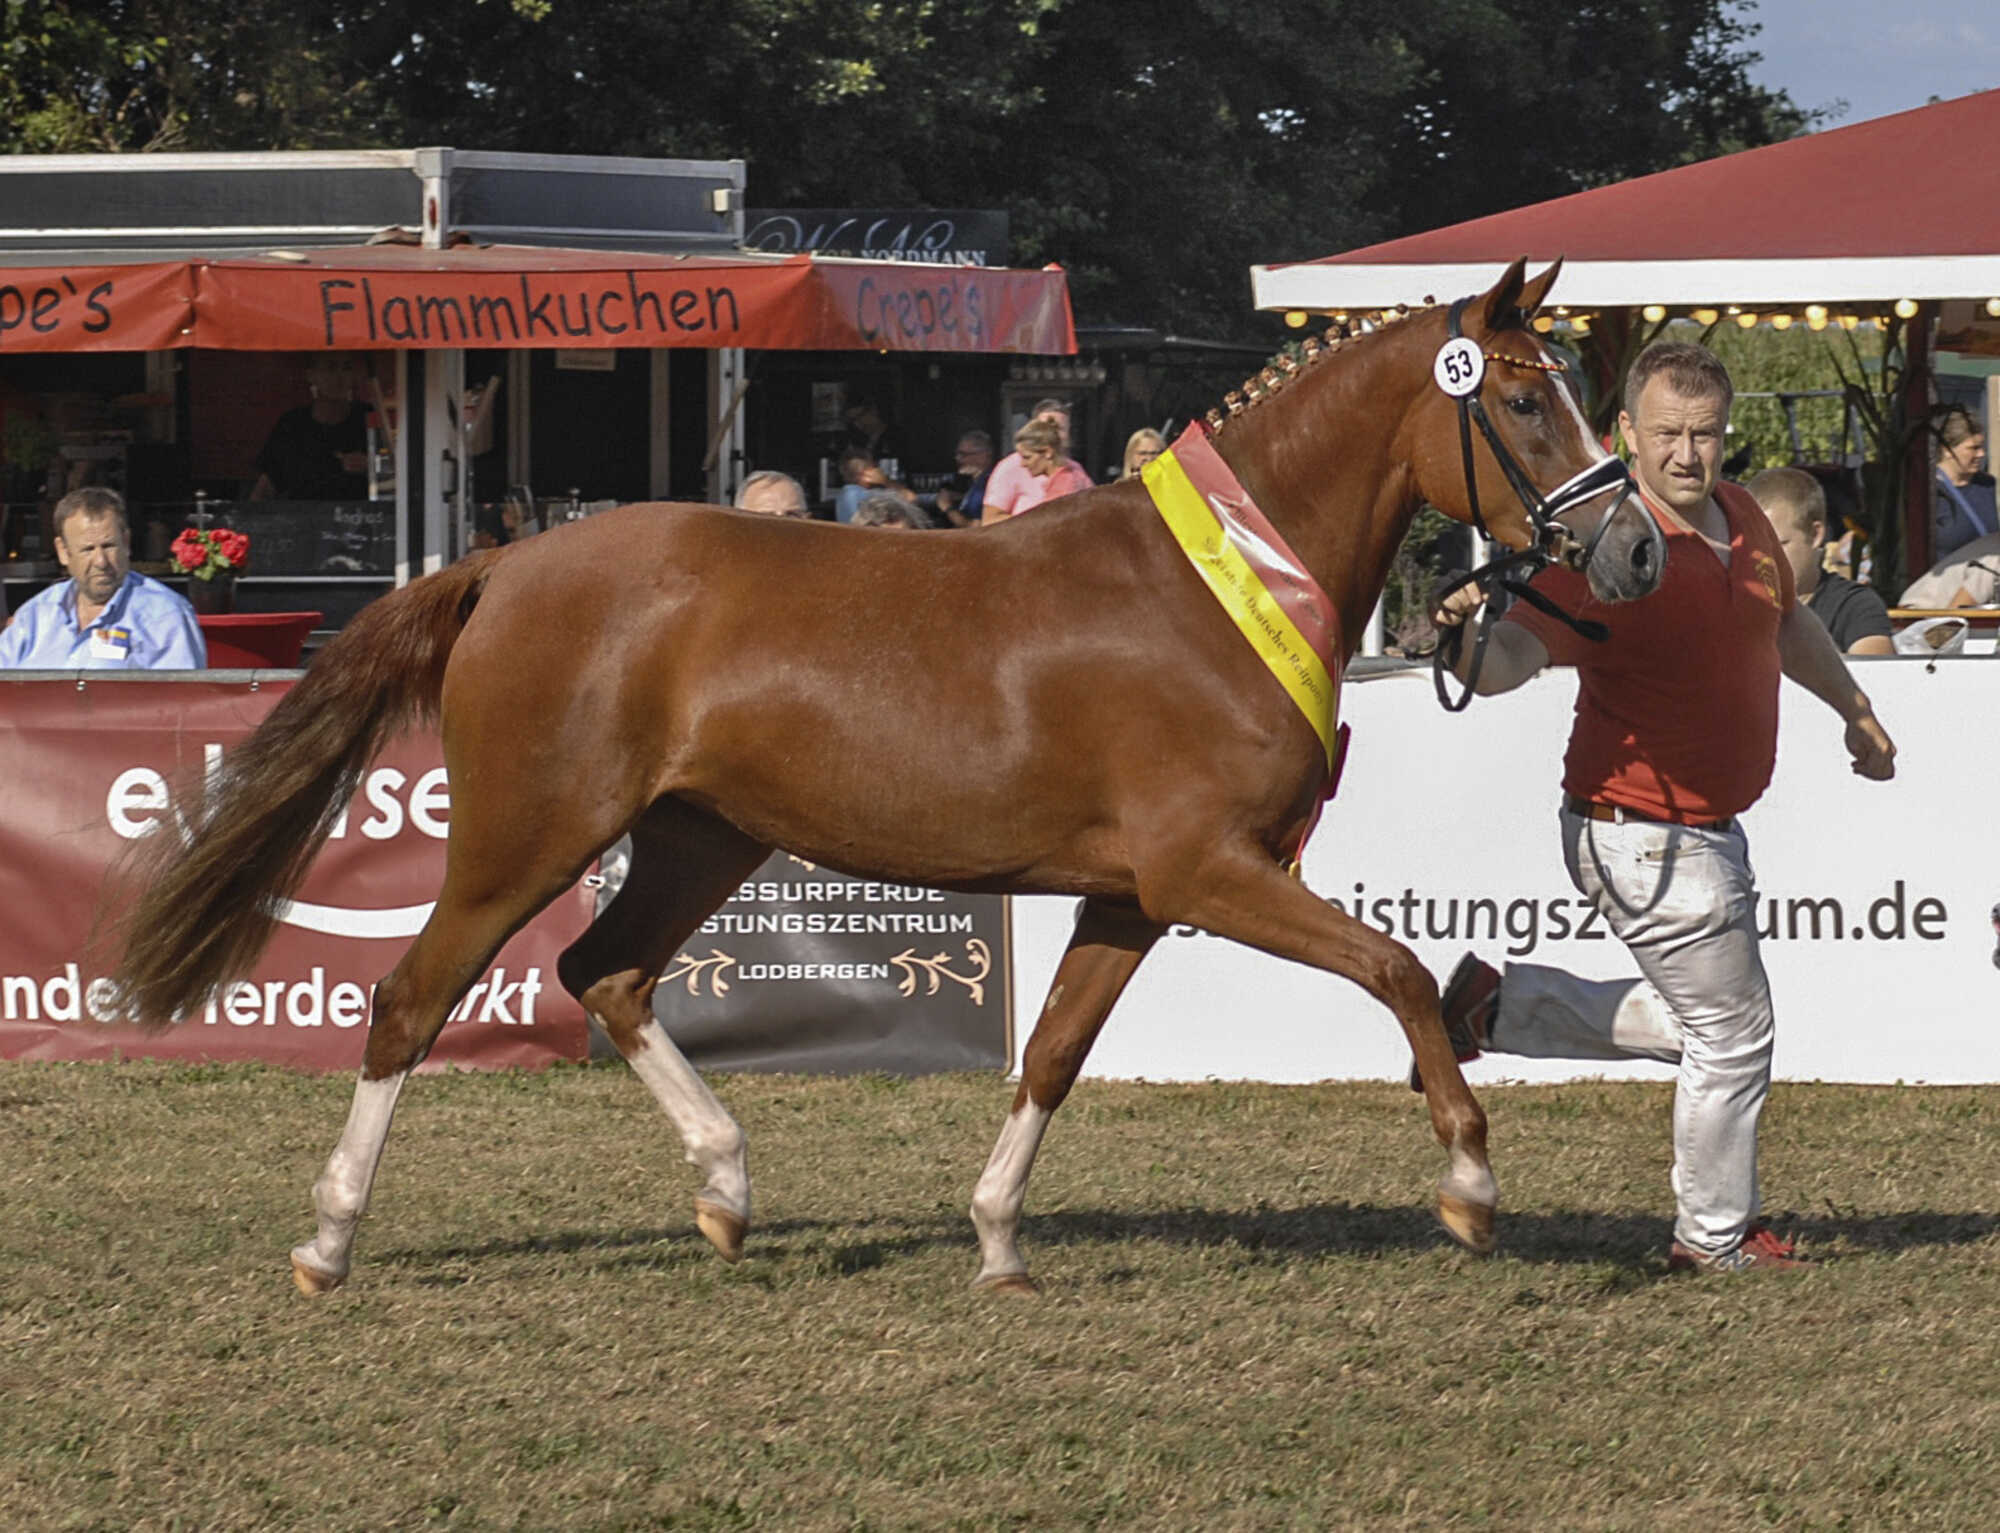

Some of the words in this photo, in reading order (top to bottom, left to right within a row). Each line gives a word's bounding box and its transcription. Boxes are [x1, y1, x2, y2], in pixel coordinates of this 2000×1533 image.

[861, 249, 987, 267] NORDMANN
[320, 271, 739, 345] Flammkuchen
[858, 277, 982, 344] Crepe's
[1444, 350, 1473, 384] 53
[1246, 596, 1289, 655] Deutsches
[727, 882, 945, 902] SSURPFERDE
[696, 913, 974, 934] STUNGSZENTRUM
[737, 963, 889, 980] LODBERGEN
